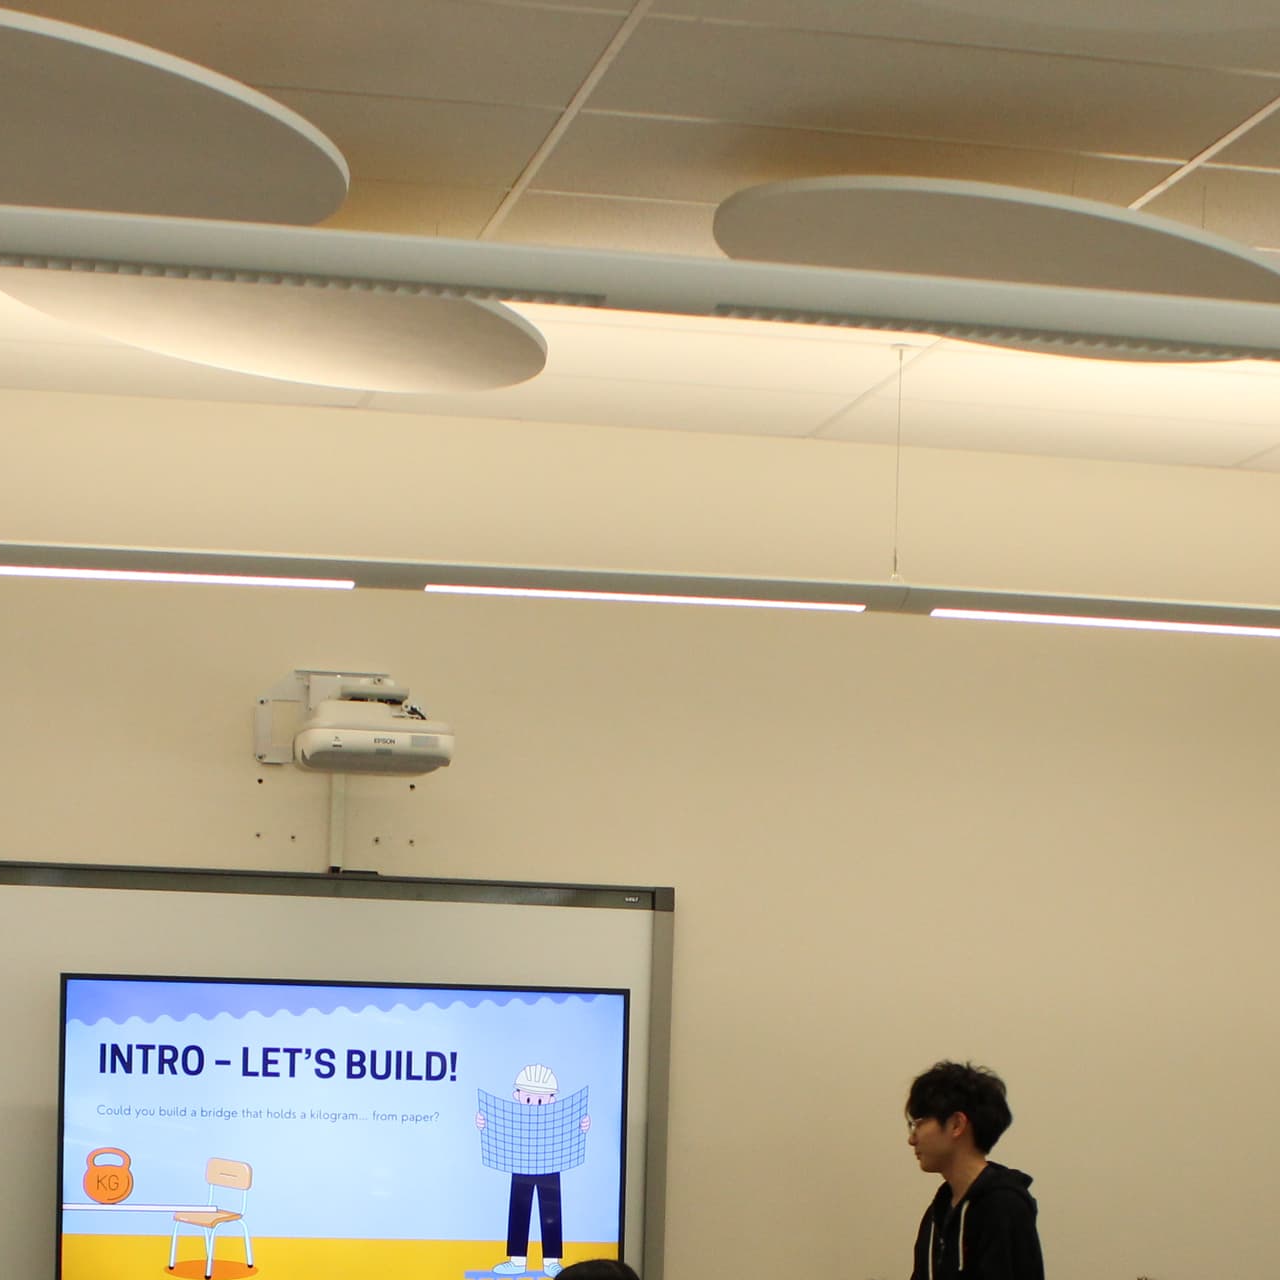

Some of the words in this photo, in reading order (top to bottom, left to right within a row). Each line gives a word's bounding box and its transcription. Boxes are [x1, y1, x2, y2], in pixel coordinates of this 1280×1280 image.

[99, 1043, 205, 1076] INTRO
[242, 1046, 336, 1079] LET’S
[346, 1049, 458, 1082] BUILD!
[96, 1104, 131, 1117] Could
[135, 1108, 155, 1119] you
[159, 1106, 187, 1118] build
[190, 1110, 197, 1118] a
[201, 1107, 238, 1121] bridge
[241, 1108, 263, 1119] that
[266, 1109, 296, 1120] holds
[300, 1112, 307, 1120] a
[310, 1110, 368, 1124] kilogram...
[372, 1110, 398, 1122] from
[401, 1111, 440, 1125] paper?
[96, 1174, 120, 1191] KG
